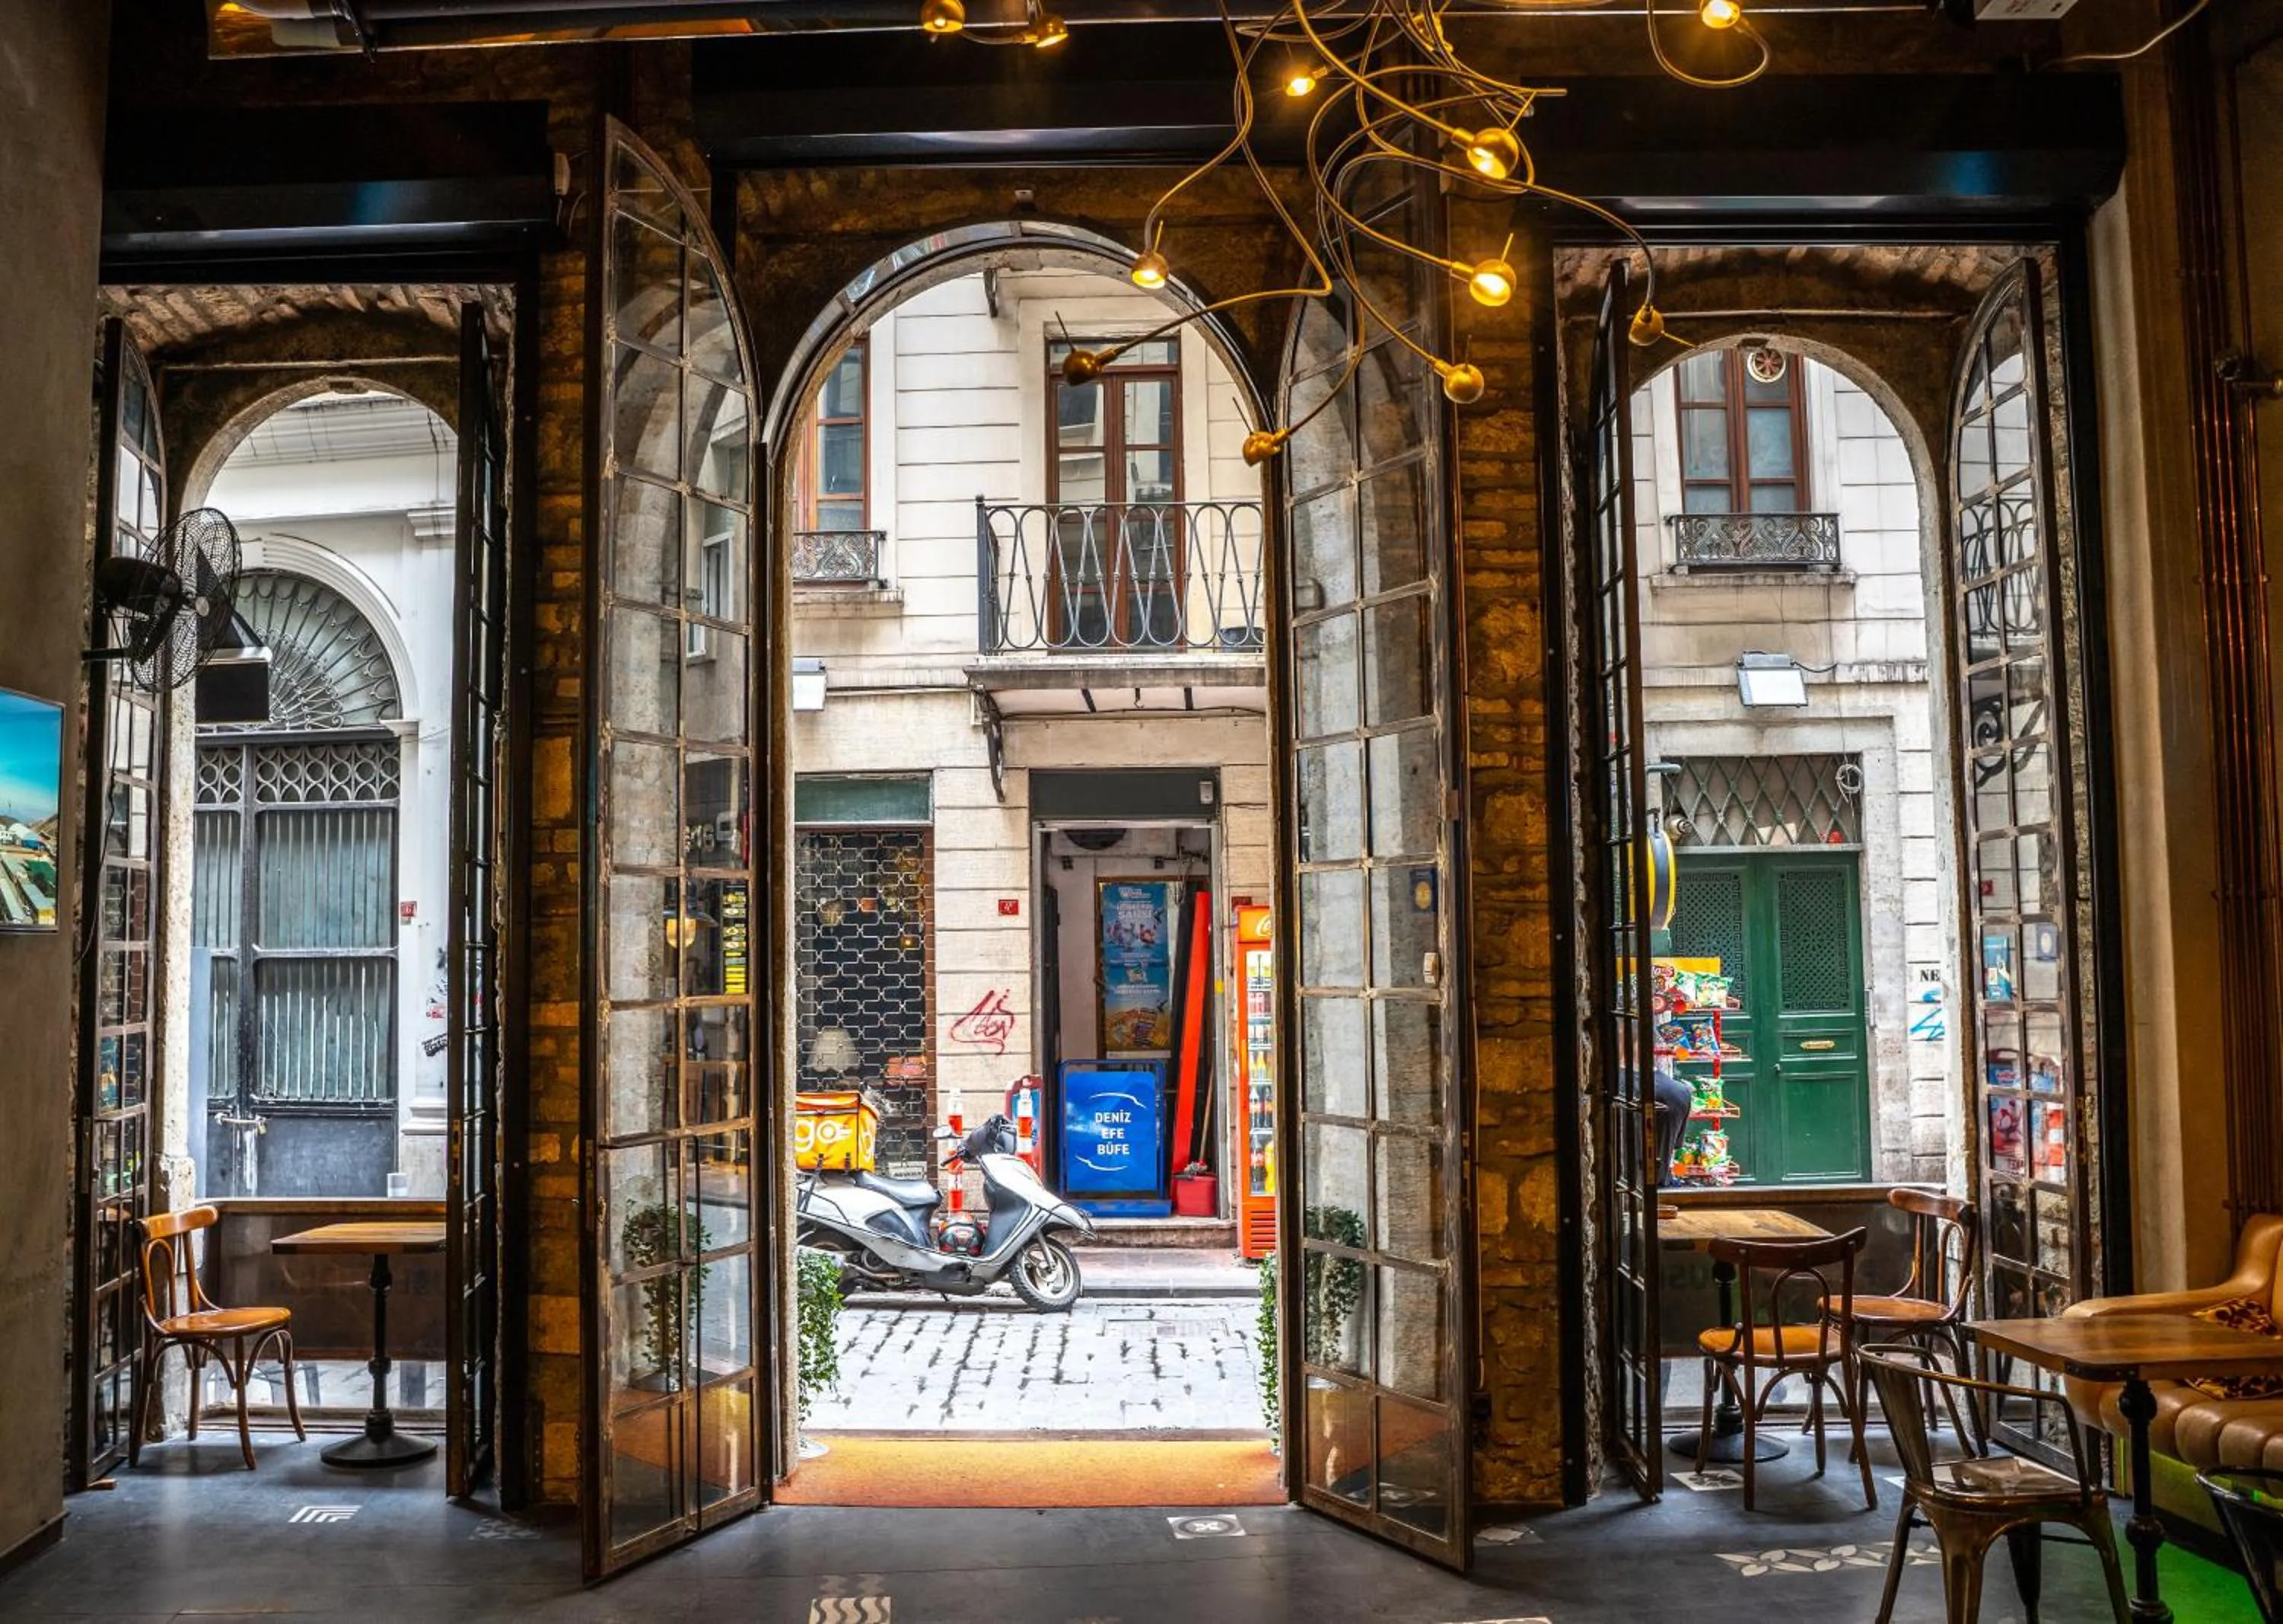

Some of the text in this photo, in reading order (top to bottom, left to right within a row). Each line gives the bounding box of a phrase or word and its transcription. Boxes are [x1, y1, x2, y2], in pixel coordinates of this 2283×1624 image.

[1095, 1109, 1132, 1123] DENİZ
[1101, 1127, 1125, 1139] EFE
[1097, 1142, 1130, 1155] BÜFE
